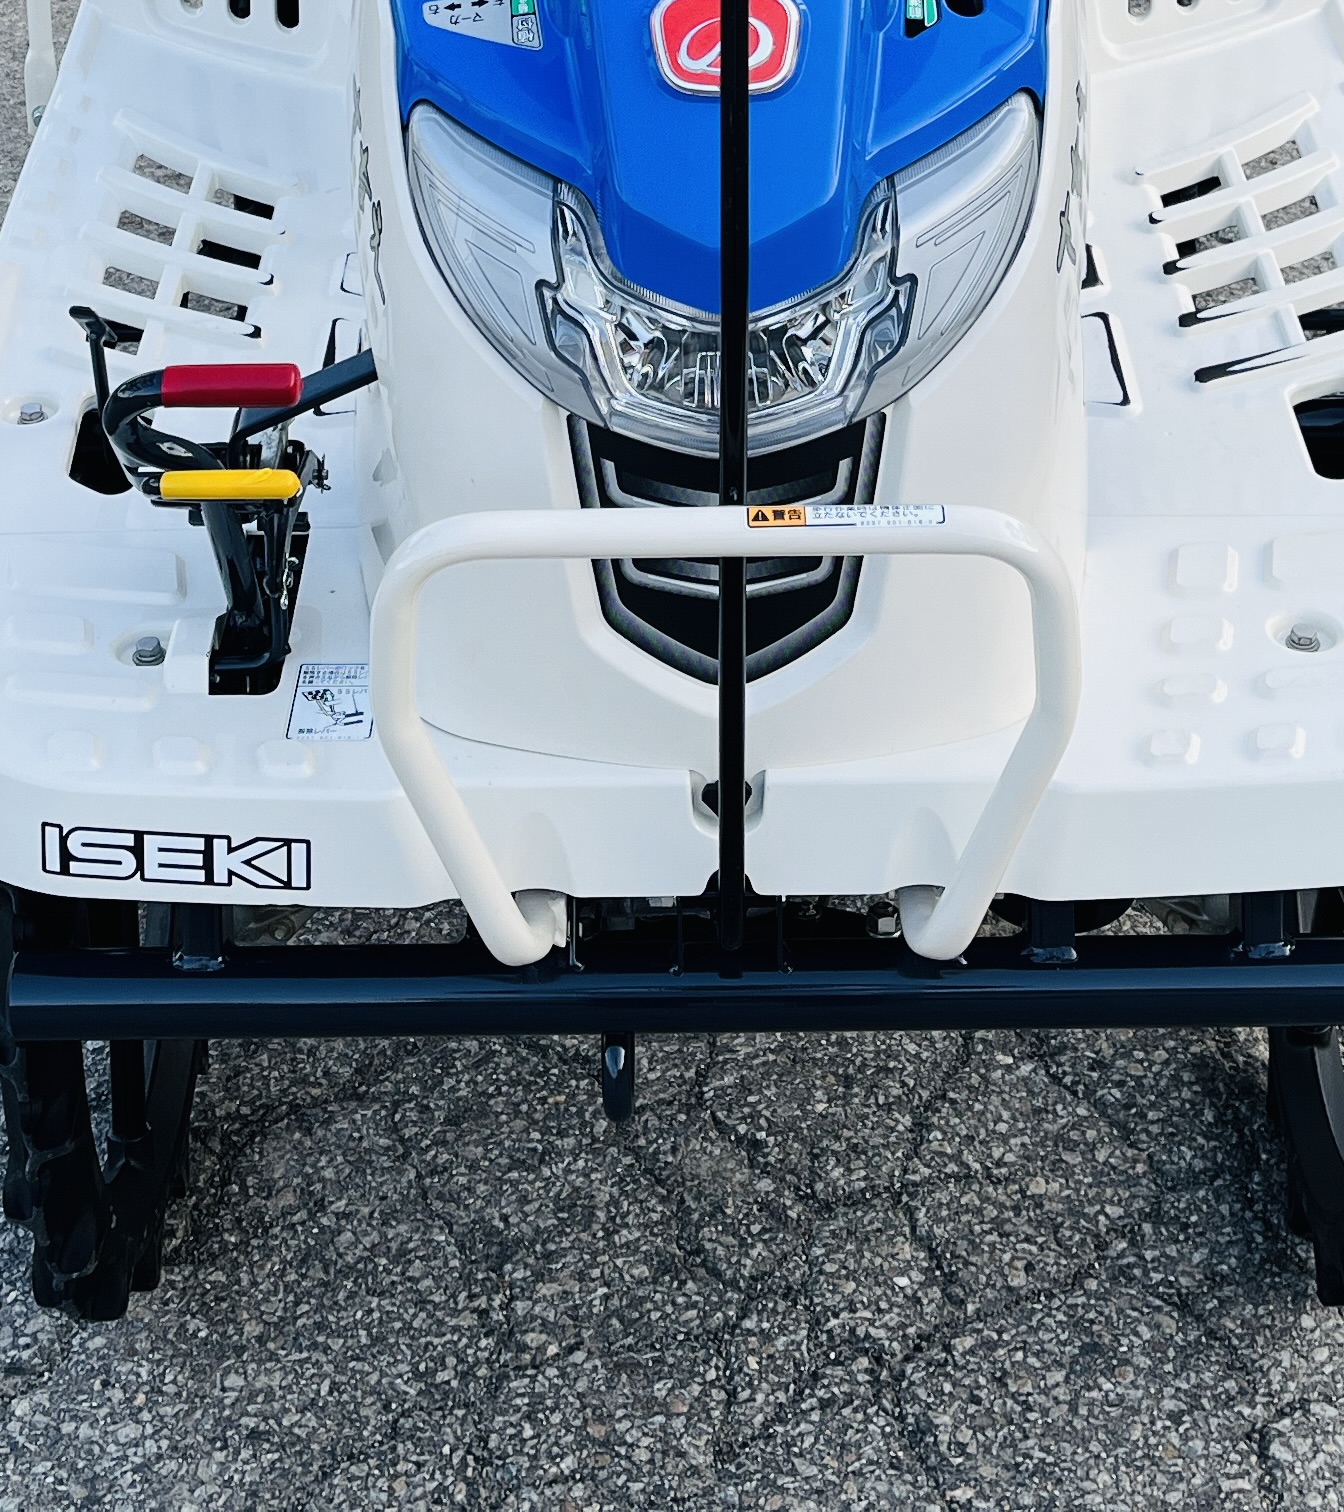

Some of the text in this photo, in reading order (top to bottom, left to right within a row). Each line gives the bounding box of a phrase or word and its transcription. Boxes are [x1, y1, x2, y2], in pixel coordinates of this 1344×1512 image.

[428, 4, 440, 15] 右
[449, 12, 484, 26] マーカ
[771, 509, 803, 521] 警告
[41, 821, 312, 891] ISEKI
